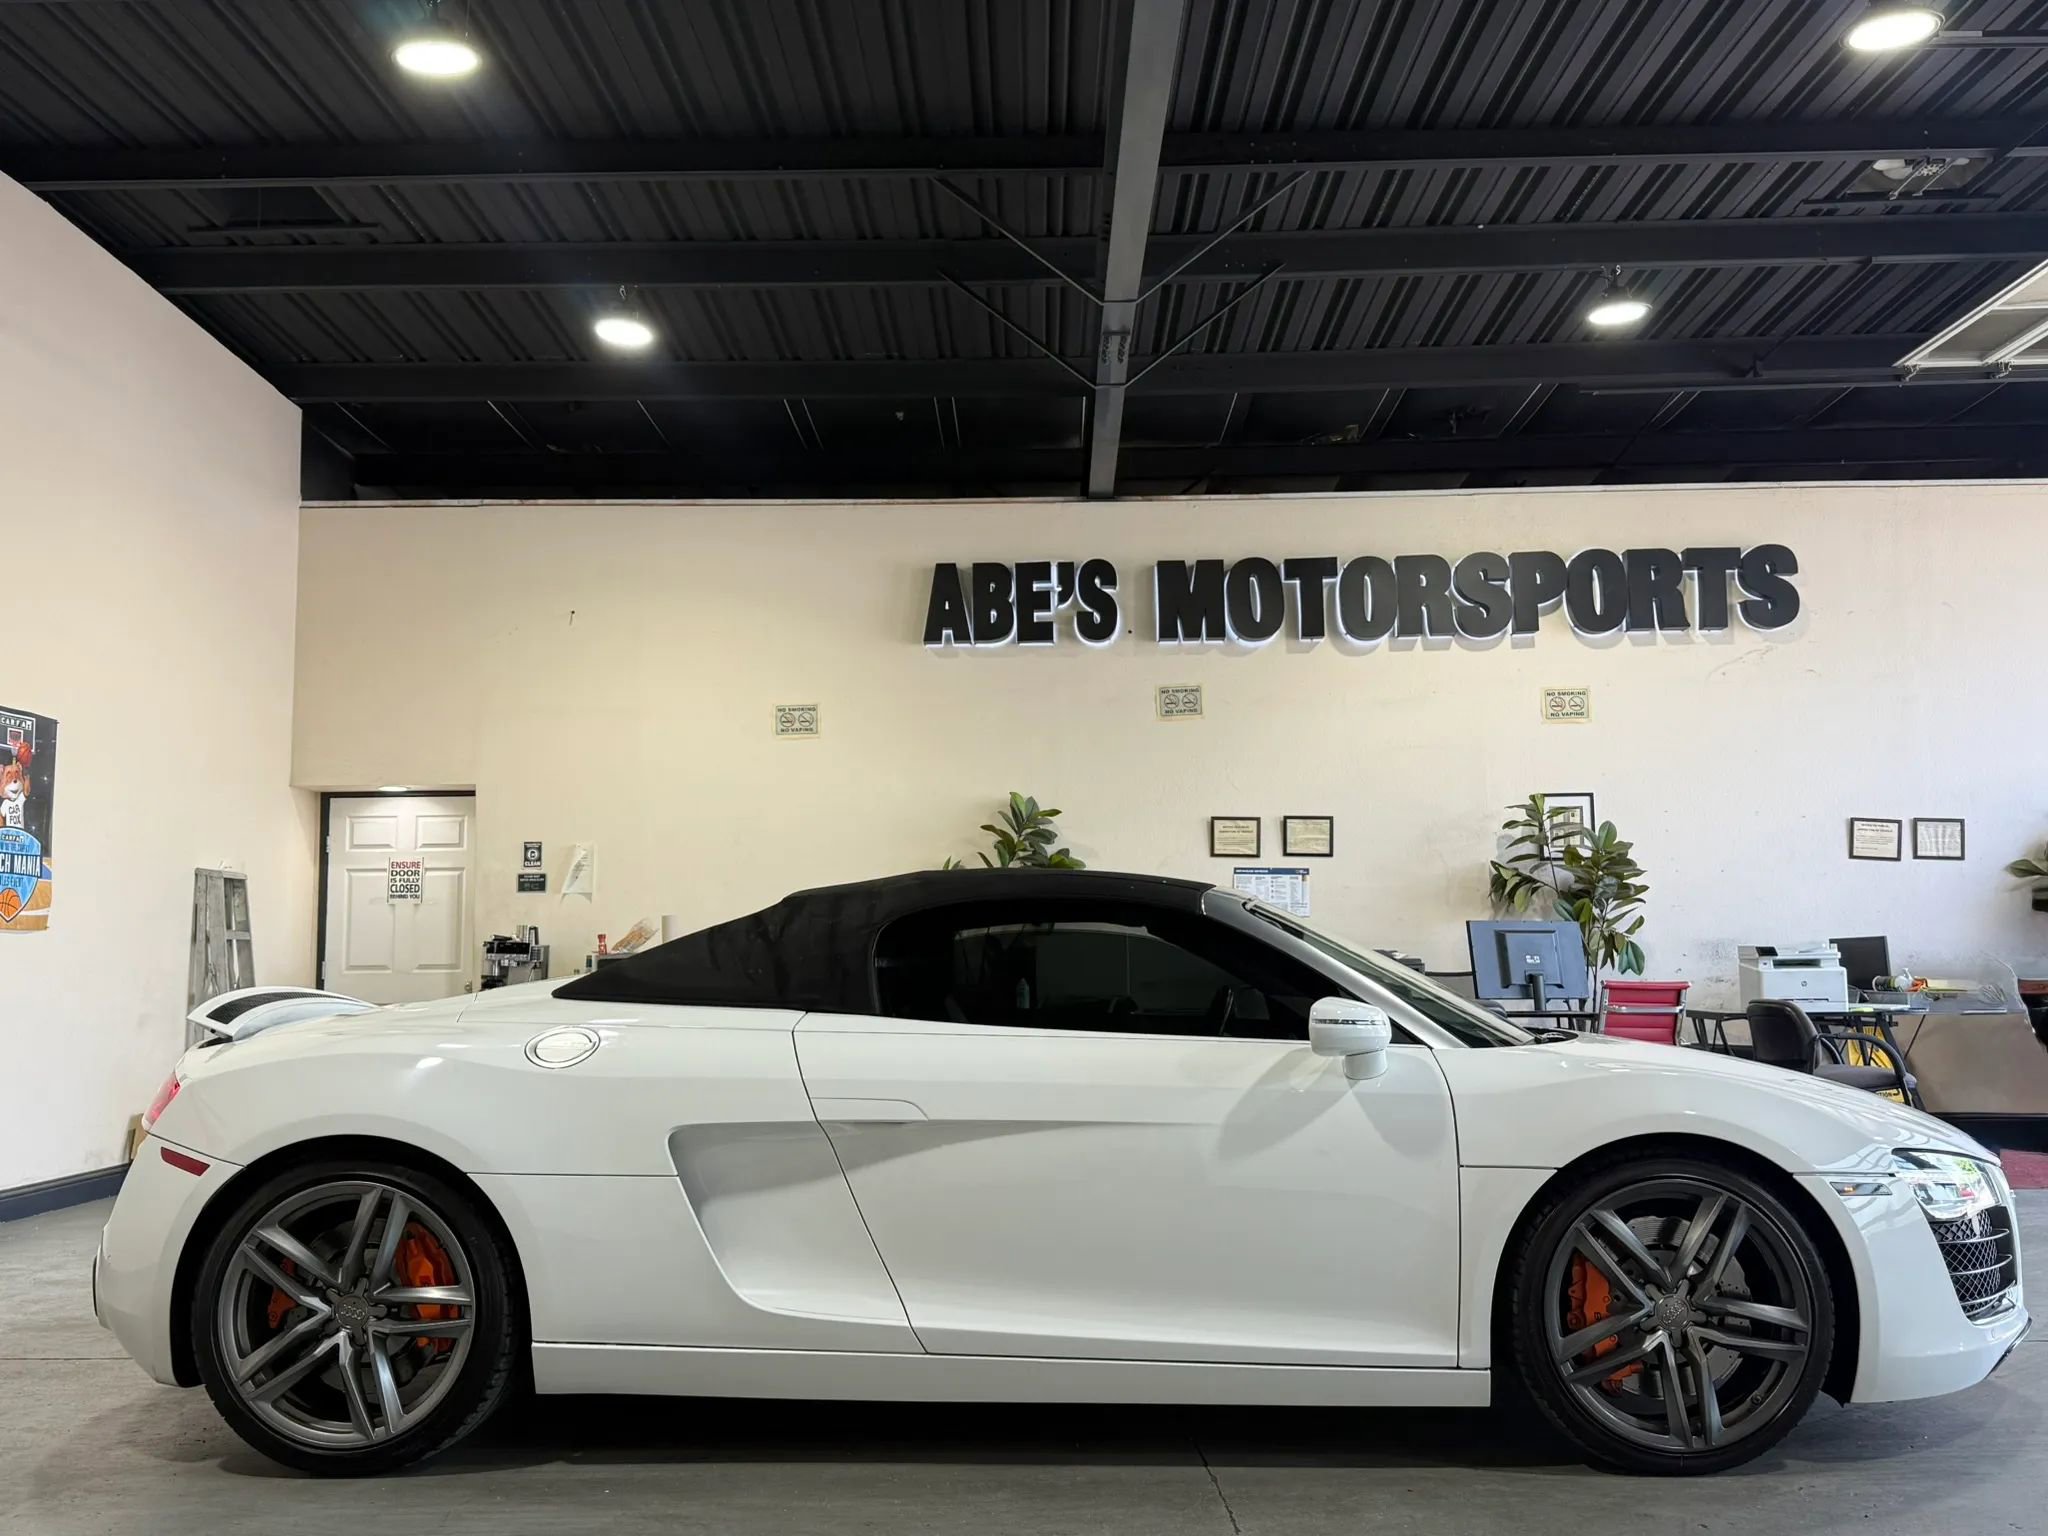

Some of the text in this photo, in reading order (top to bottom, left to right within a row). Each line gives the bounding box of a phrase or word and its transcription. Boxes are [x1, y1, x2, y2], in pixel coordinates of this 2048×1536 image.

[923, 543, 1800, 645] ABE'S MOTORSPORTS
[8, 804, 21, 814] CAR
[9, 815, 21, 825] FOX
[13, 854, 41, 877] MANIA
[391, 861, 421, 869] ENSURE
[391, 869, 421, 877] DOOR
[390, 883, 420, 893] CLOSED
